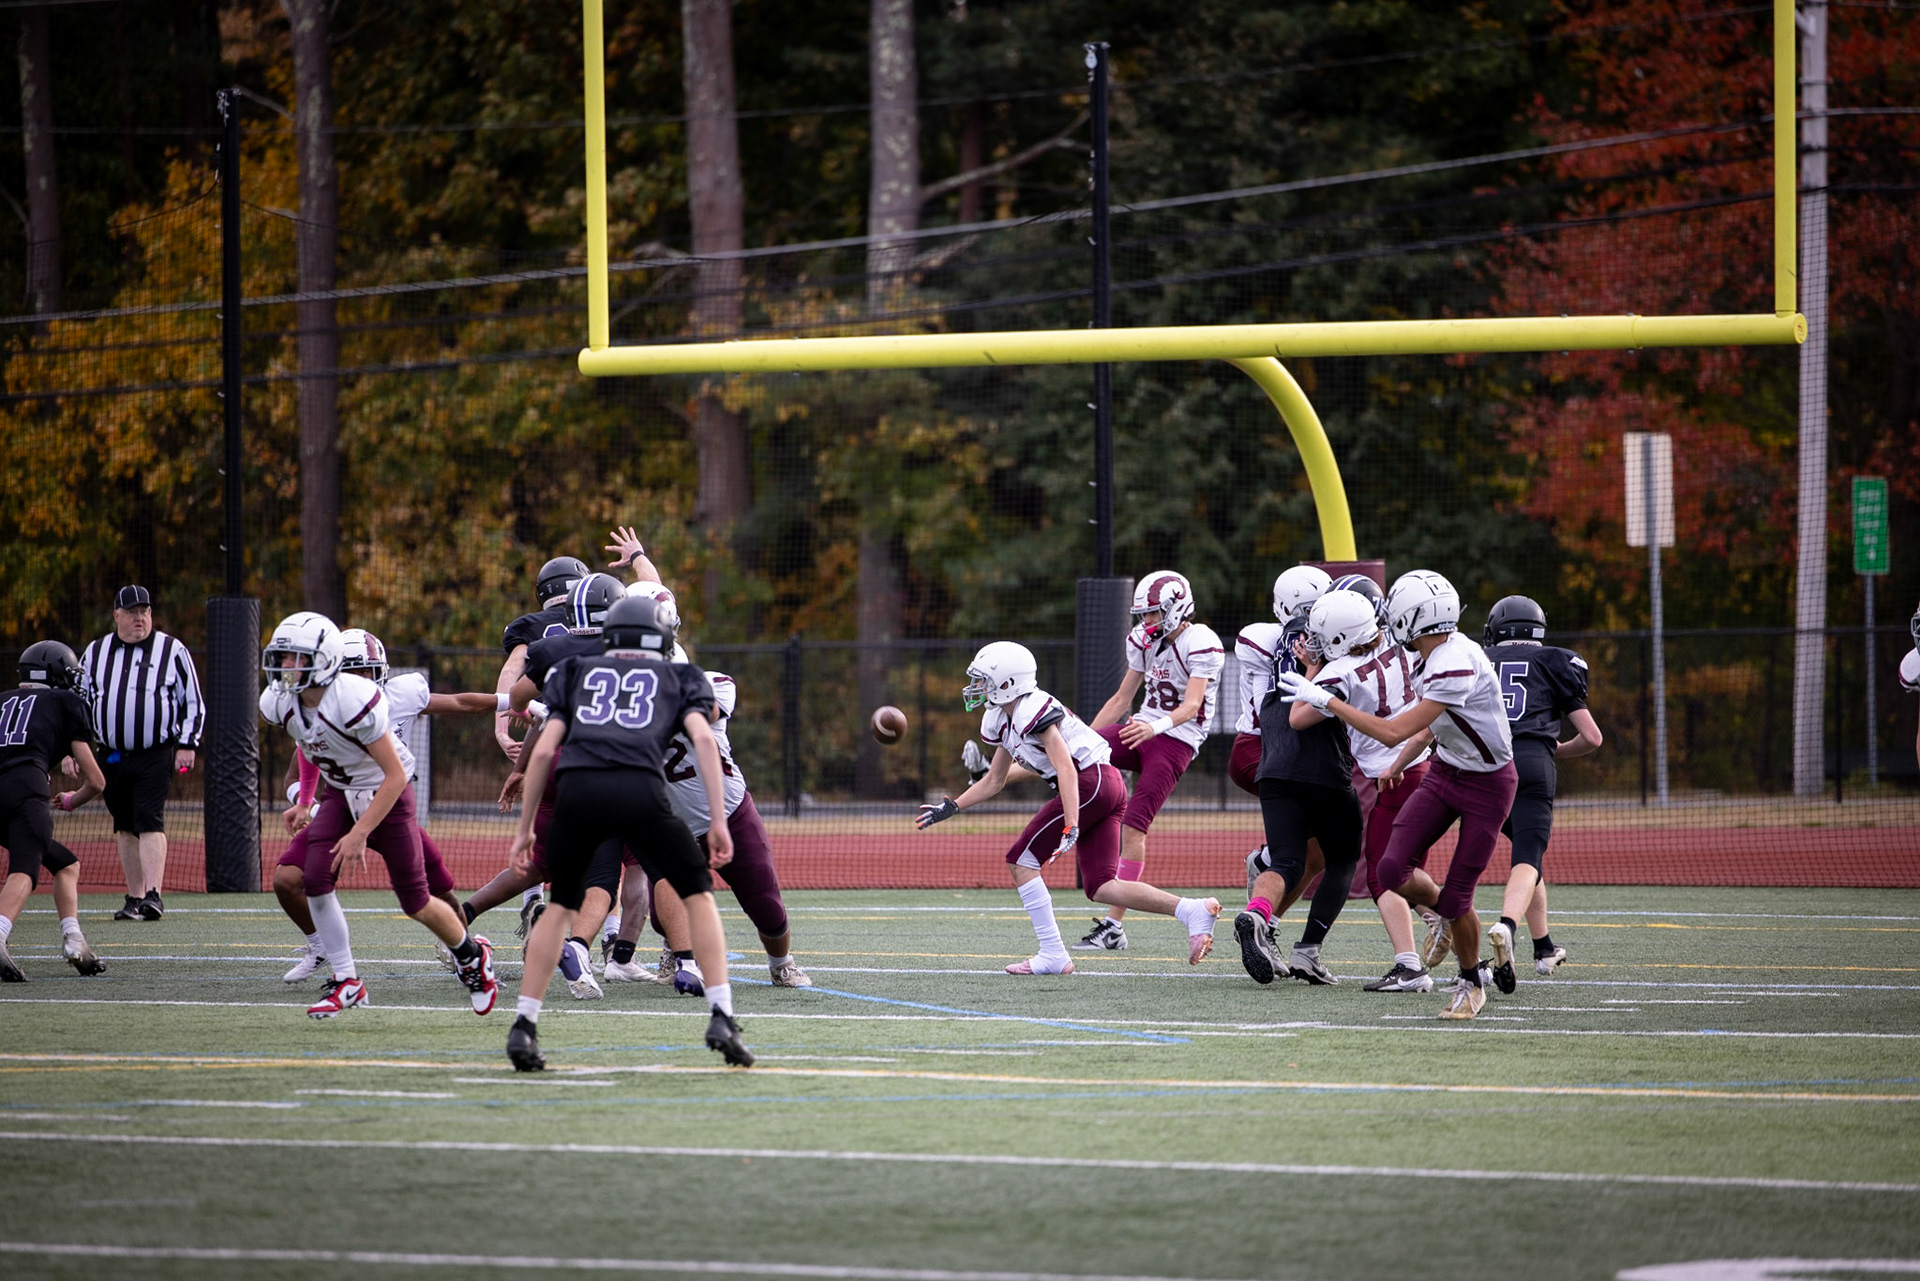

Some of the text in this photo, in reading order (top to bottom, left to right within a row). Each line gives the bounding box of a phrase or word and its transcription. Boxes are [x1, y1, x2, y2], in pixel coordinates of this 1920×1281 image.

[576, 667, 659, 729] 33
[1354, 646, 1416, 718] 77
[0, 694, 37, 747] 11
